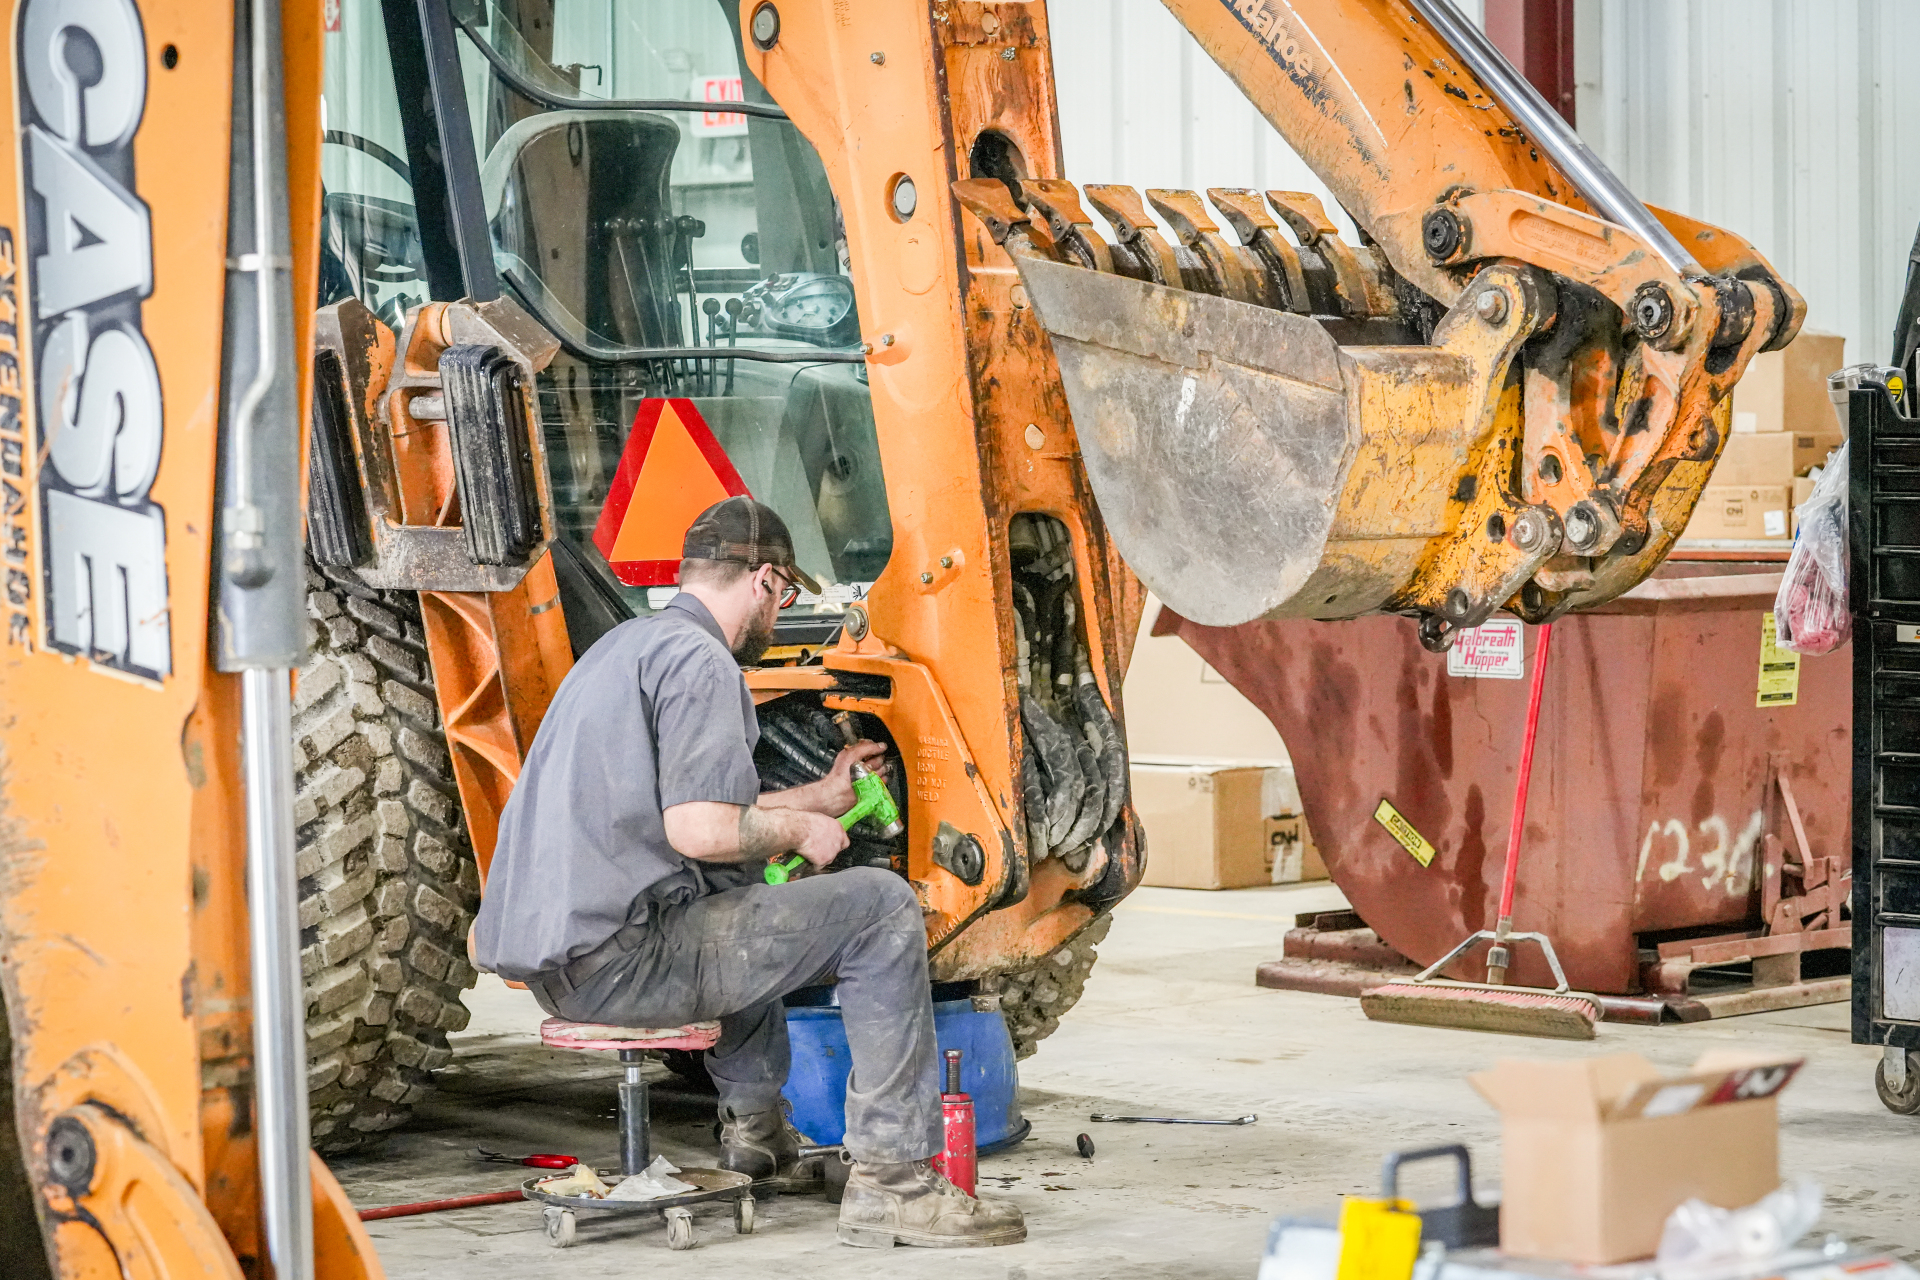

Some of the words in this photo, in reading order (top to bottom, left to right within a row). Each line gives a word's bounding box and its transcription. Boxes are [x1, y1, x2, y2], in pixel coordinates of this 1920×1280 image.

[703, 79, 745, 128] EXIT
[22, 0, 171, 685] CASE
[1464, 646, 1509, 671] Hopper
[917, 748, 949, 761] DUCTILE
[917, 761, 936, 774] IRON
[917, 776, 928, 788] DO
[931, 778, 947, 790] NOT
[917, 790, 940, 803] WELD
[1391, 815, 1422, 849] CATION
